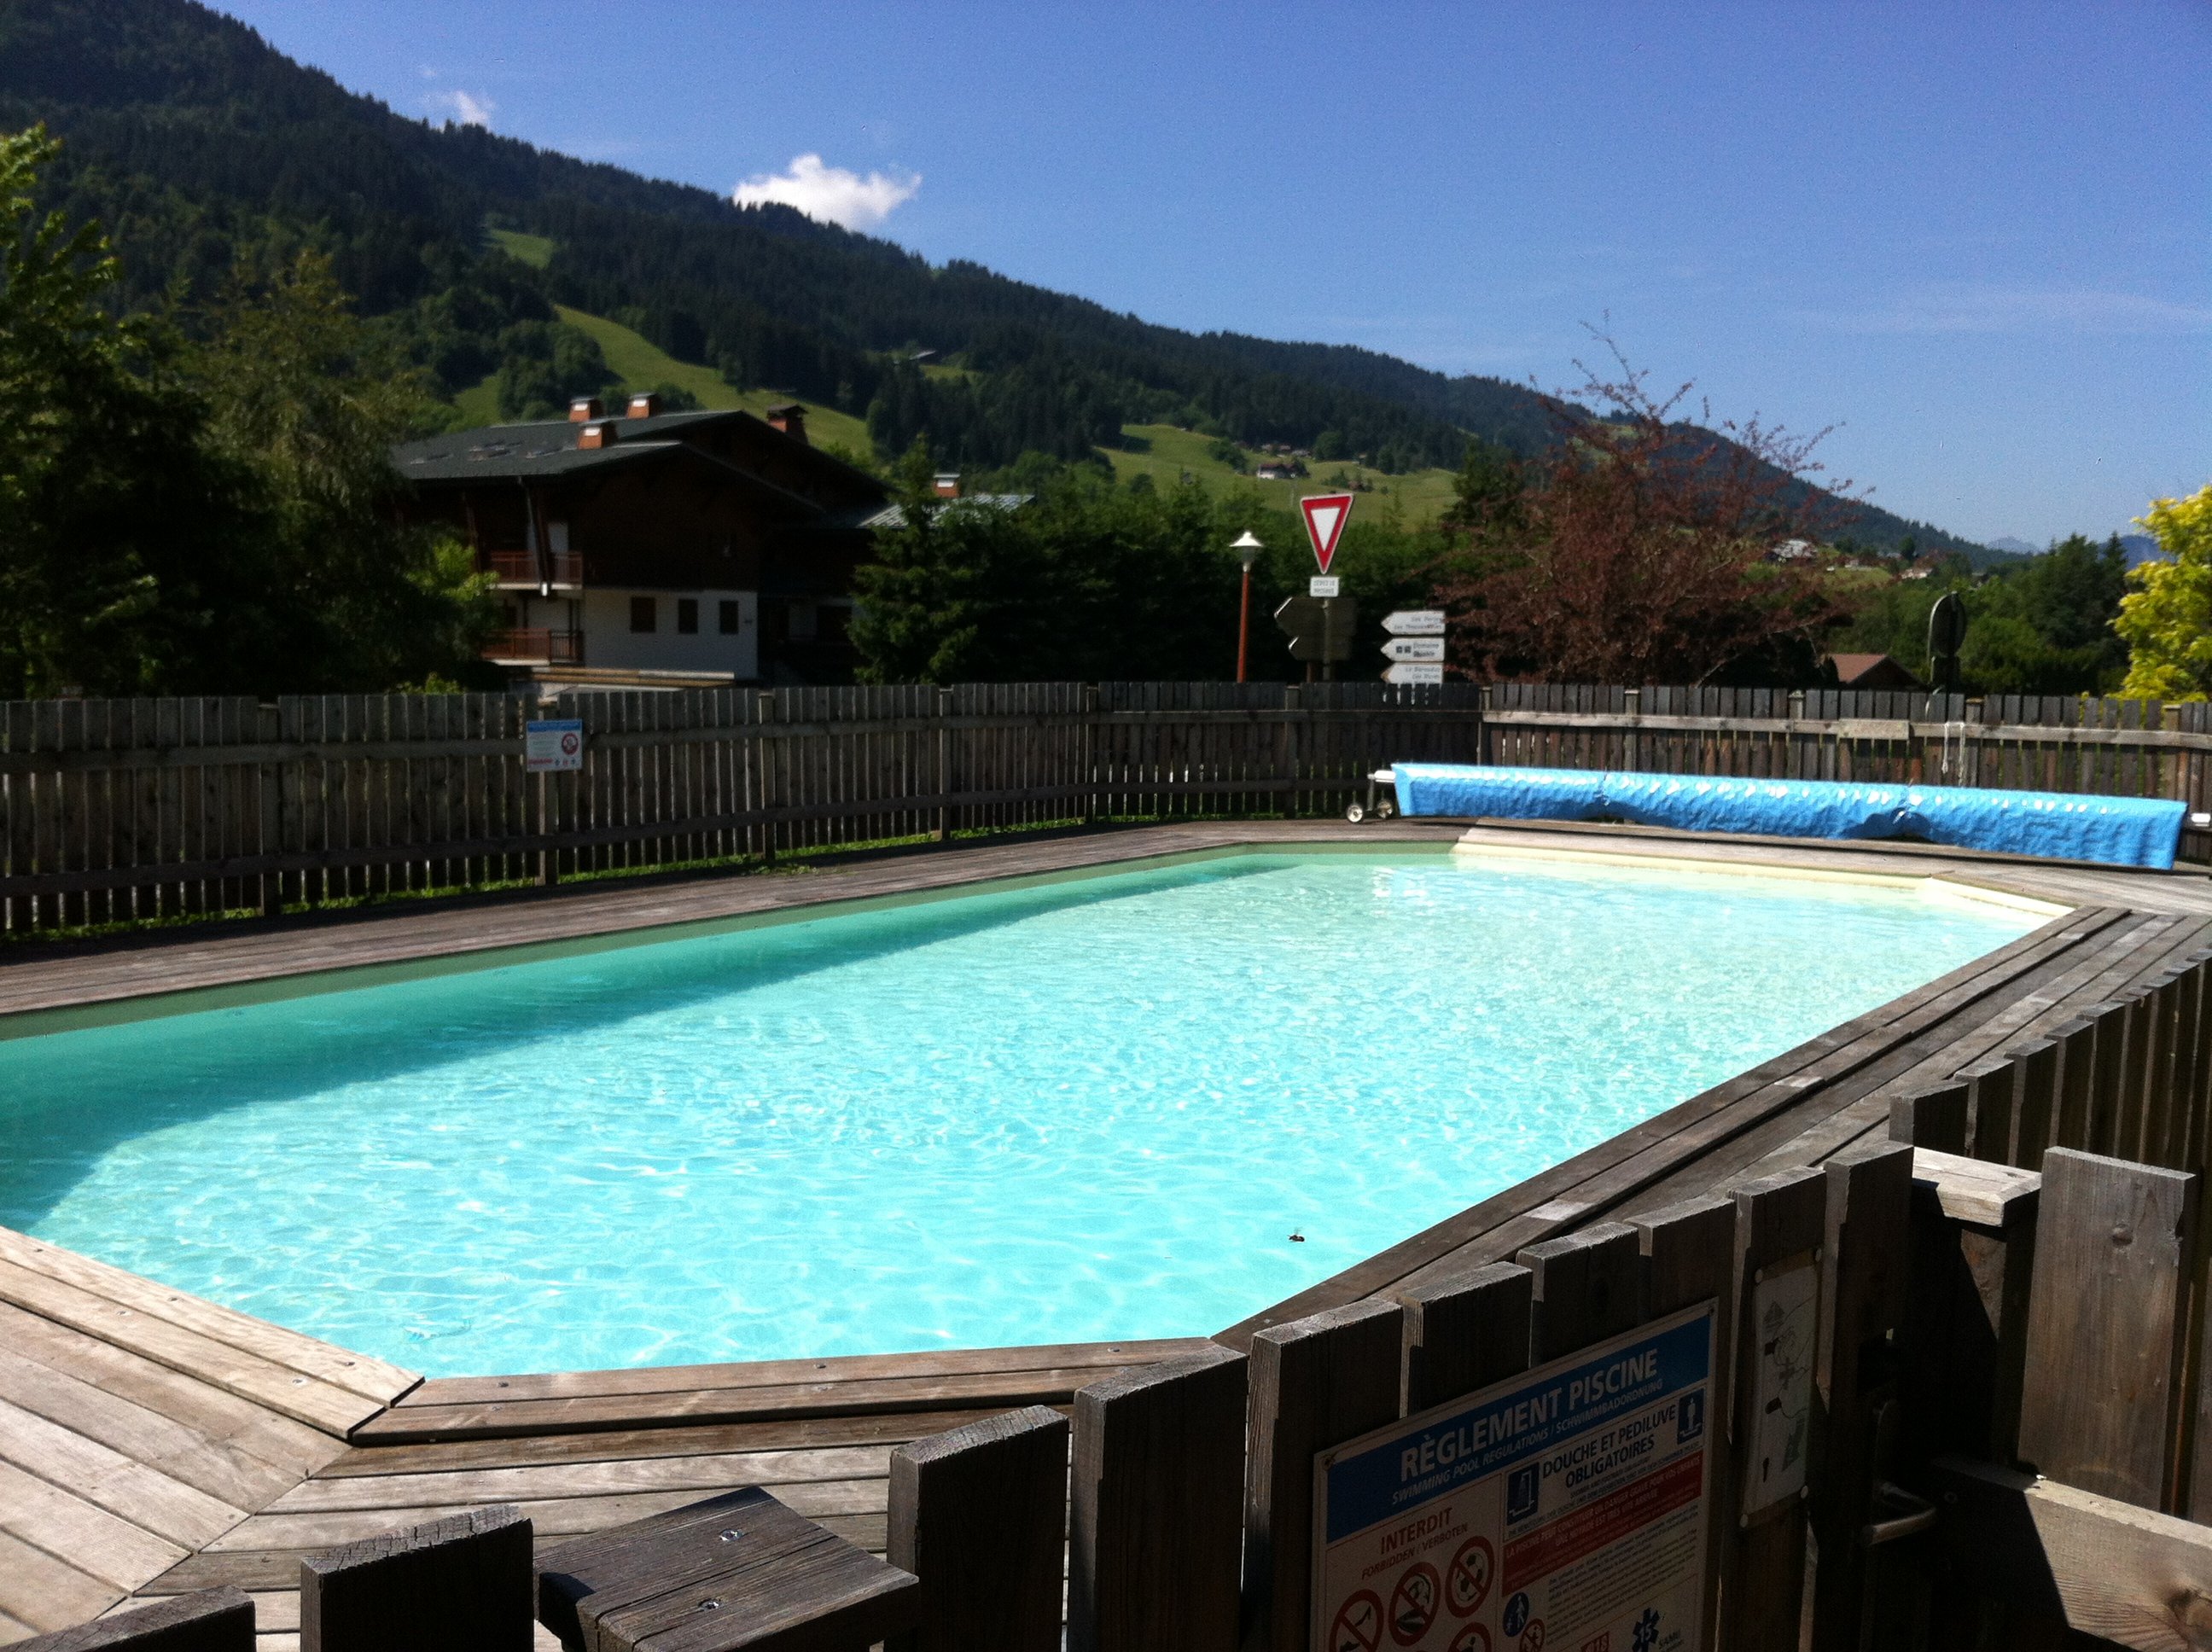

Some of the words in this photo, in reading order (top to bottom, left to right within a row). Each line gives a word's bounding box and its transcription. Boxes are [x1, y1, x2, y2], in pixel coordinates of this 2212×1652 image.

[1392, 1469, 1451, 1504] SWIMMING
[1453, 1458, 1479, 1479] POOL
[1482, 1427, 1549, 1463] REGULATIONS
[1556, 1378, 1663, 1434] SCHWIMMBADORDNUNG
[1400, 1387, 1563, 1481] RÈGLEMENT
[1569, 1348, 1657, 1411] PISCINE
[1543, 1439, 1598, 1479] DOUCHE
[1600, 1431, 1615, 1453] ET
[1618, 1404, 1676, 1444] PEDILUVE
[1565, 1434, 1655, 1488] OBLIGATOIRES
[1362, 1546, 1415, 1579] FORBIDDEN
[1422, 1522, 1469, 1551] VERBOTEN
[1381, 1508, 1452, 1555] INTERDIT
[1639, 1622, 1652, 1643] 15
